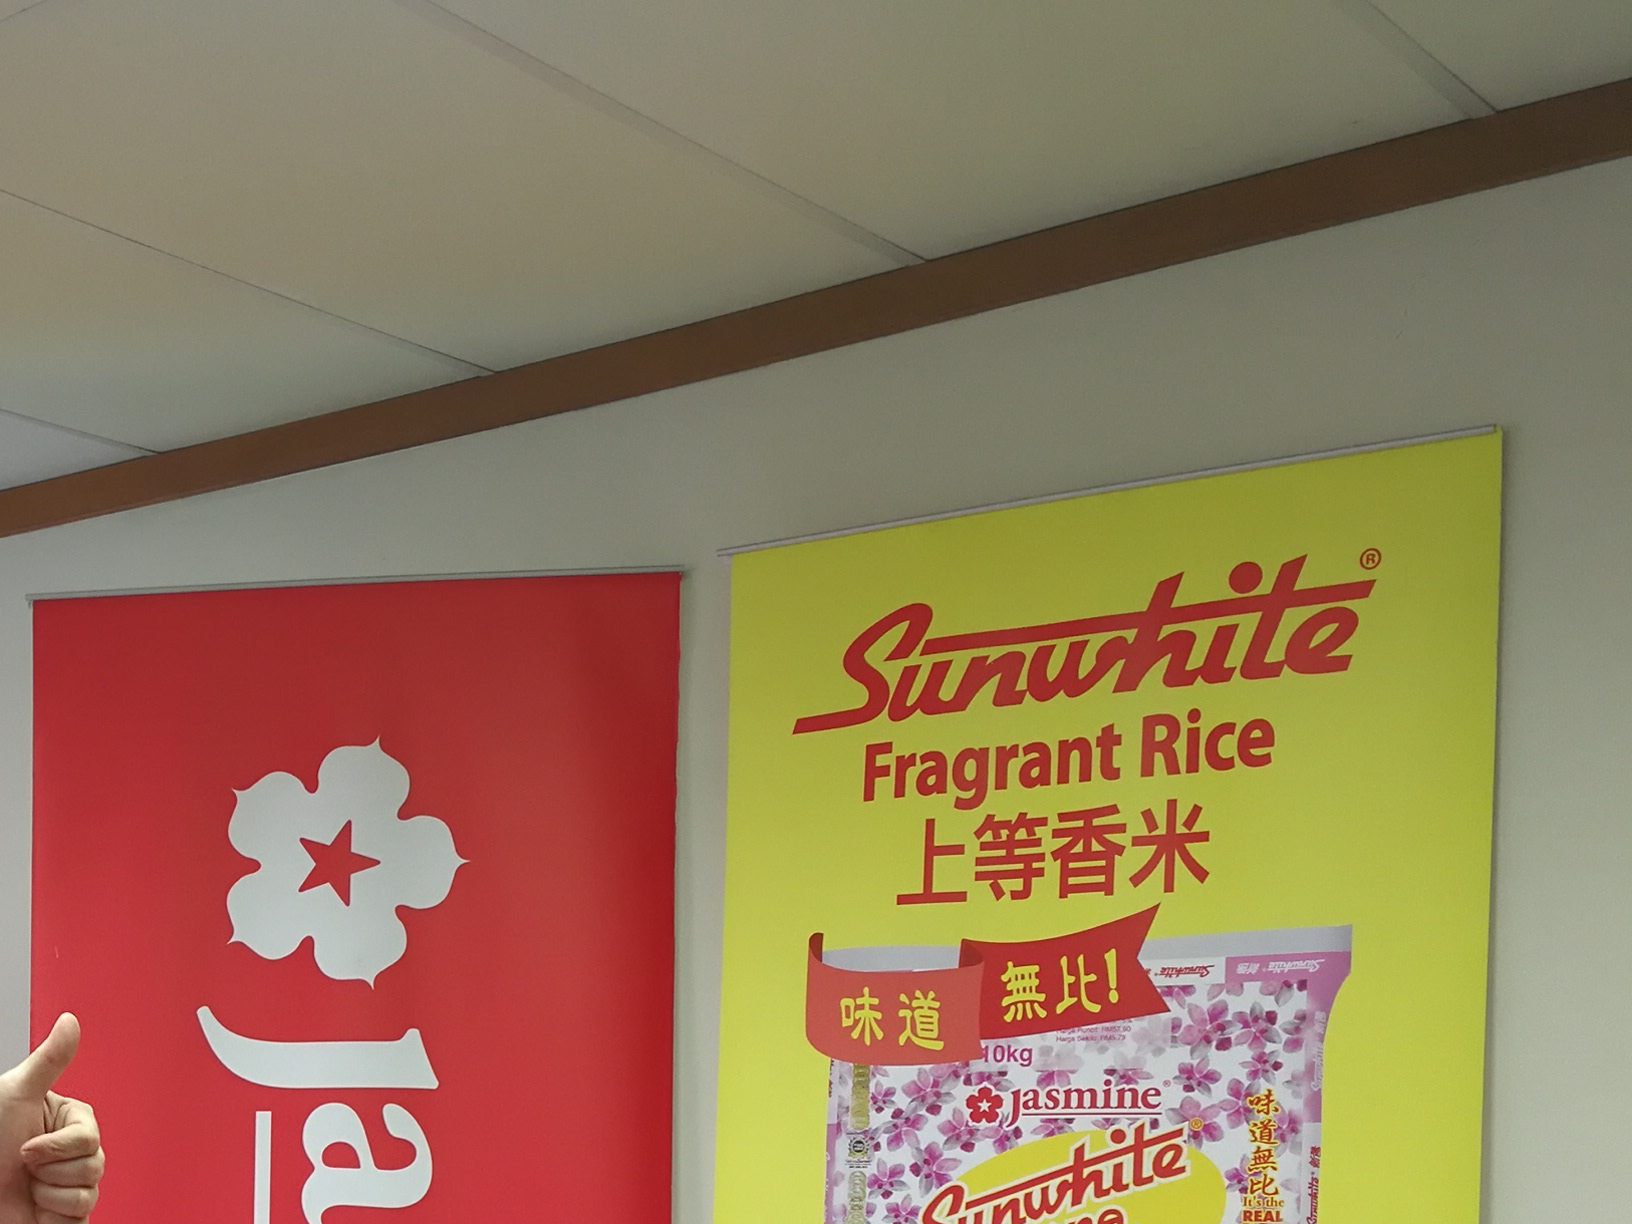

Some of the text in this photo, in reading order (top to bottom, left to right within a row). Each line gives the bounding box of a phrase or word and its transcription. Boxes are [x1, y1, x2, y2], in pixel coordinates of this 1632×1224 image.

[792, 553, 1377, 735] Sunwhite
[863, 708, 1276, 811] Fragrant Rice
[897, 798, 1210, 906] 上等香米
[840, 948, 1118, 1051] 味道 無比!
[1007, 1079, 1162, 1127] Jasmine
[1248, 1088, 1280, 1197] 味道無比
[1242, 1196, 1284, 1208] It's the
[1242, 1209, 1283, 1222] REAL
